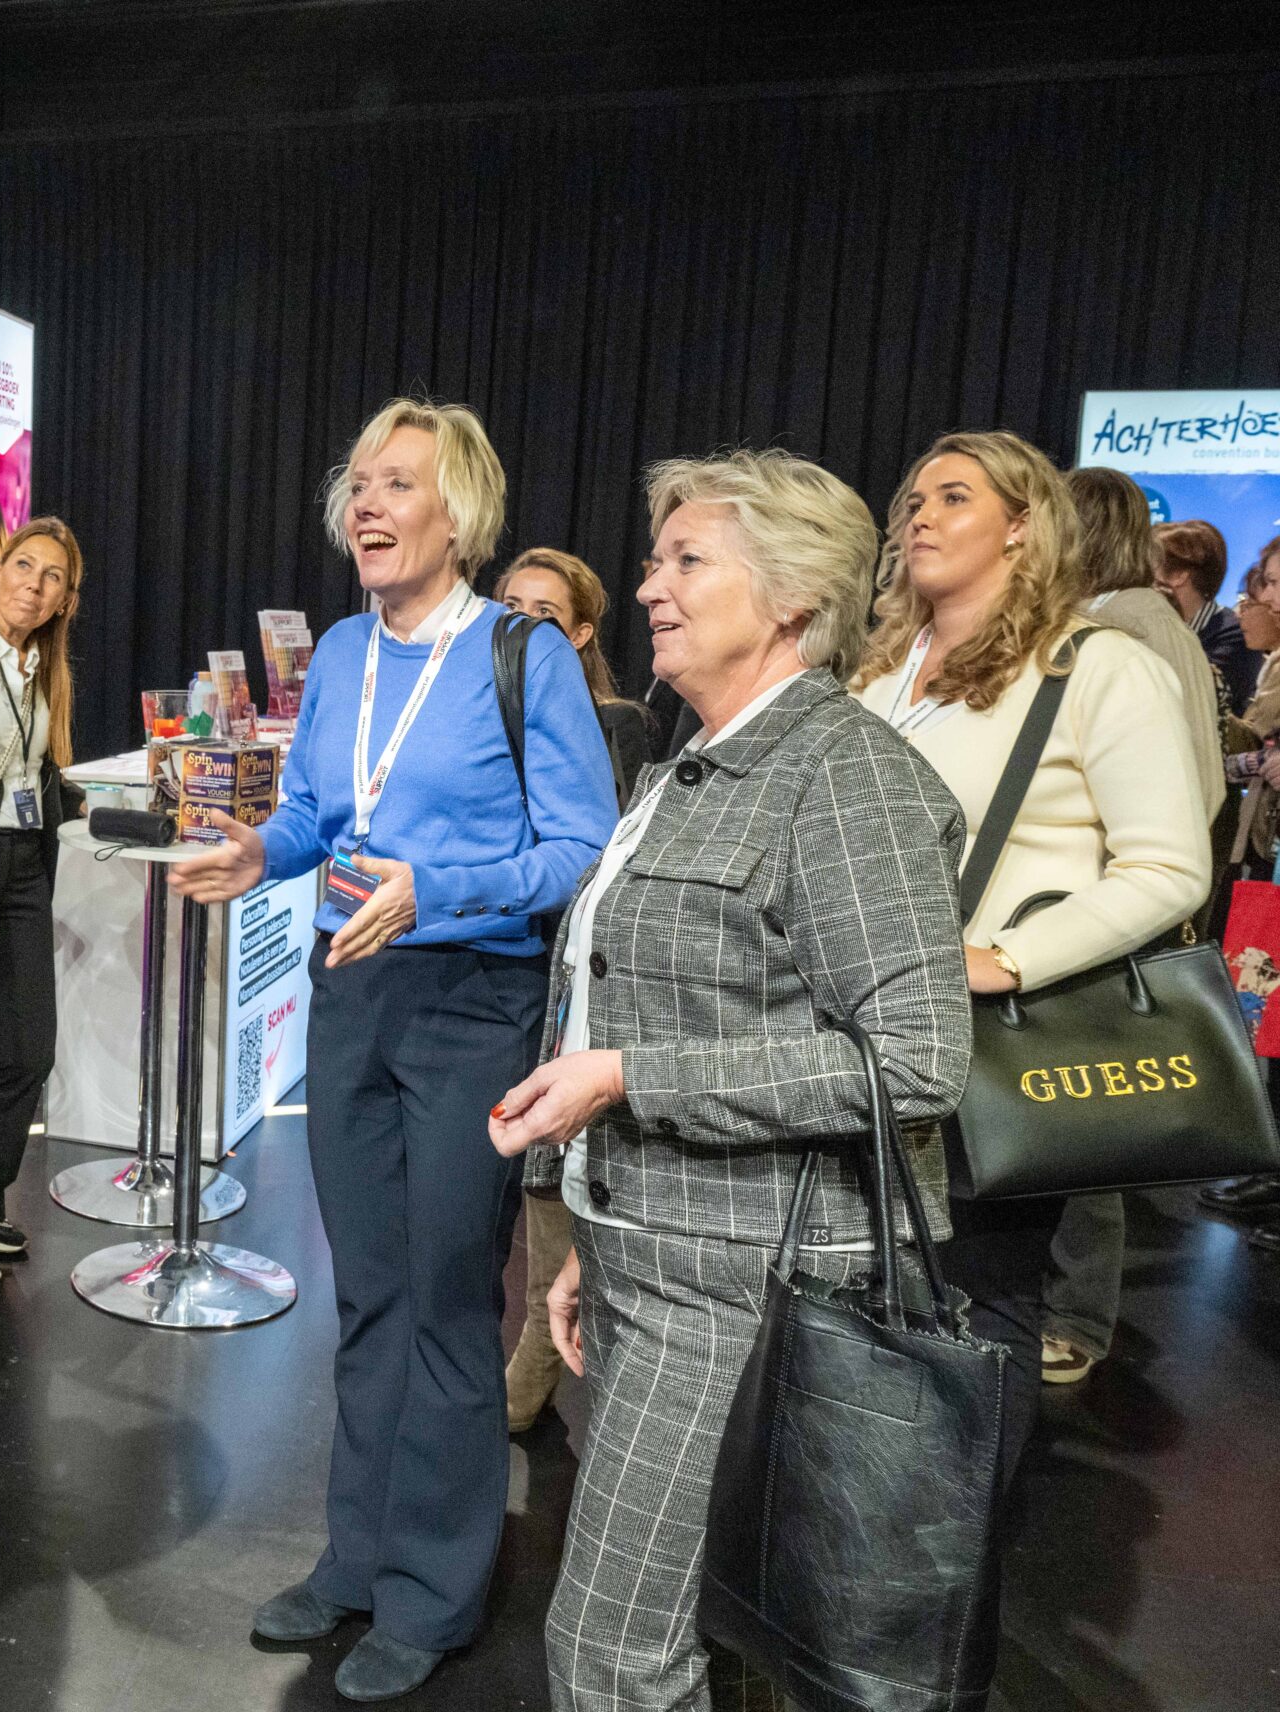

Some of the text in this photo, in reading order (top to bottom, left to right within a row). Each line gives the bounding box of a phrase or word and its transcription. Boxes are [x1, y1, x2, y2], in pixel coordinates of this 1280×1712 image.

[1091, 399, 1280, 456] ACHTERHOE
[1192, 447, 1260, 459] convention
[436, 631, 454, 659] SUPPORT
[188, 751, 213, 768] Spin
[213, 761, 236, 777] WIN
[374, 765, 389, 794] SUPPORT
[185, 803, 210, 818] Spin
[267, 1002, 286, 1032] SCAN
[1021, 1054, 1197, 1102] GUESS
[812, 1229, 829, 1243] ZS
